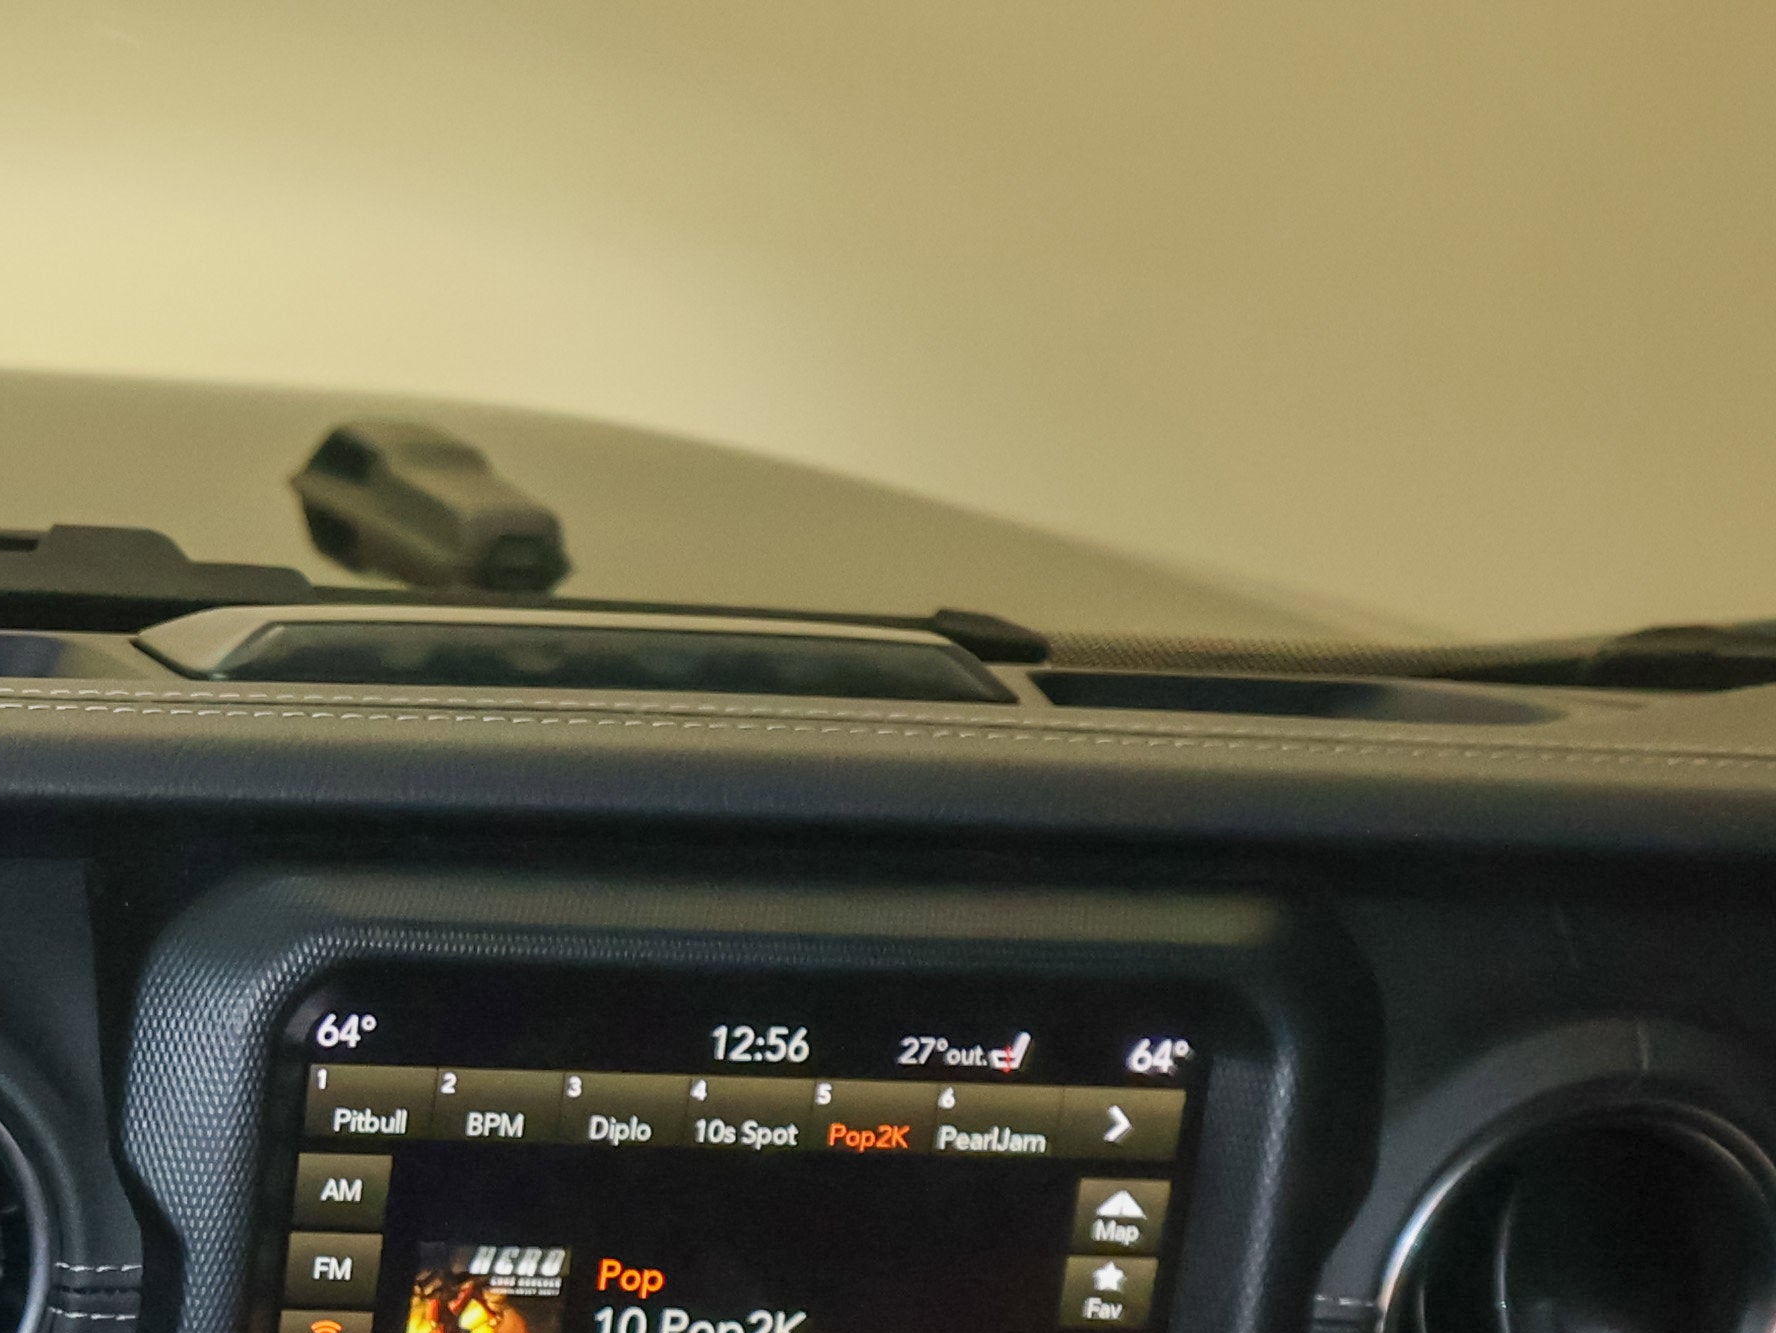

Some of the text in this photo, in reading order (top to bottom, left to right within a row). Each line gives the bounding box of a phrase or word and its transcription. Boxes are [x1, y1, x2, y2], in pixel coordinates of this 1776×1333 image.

[316, 1014, 377, 1048] 64°
[711, 1025, 810, 1063] 12:56
[1127, 1039, 1190, 1074] 64°
[317, 1070, 328, 1089] 1
[441, 1073, 457, 1093] 2
[565, 1077, 582, 1097] 3
[690, 1080, 707, 1100] 4
[815, 1083, 832, 1104] 5
[938, 1089, 955, 1108] 6
[334, 1108, 407, 1134] Pitbull
[466, 1113, 525, 1138] BPM
[588, 1115, 651, 1145] Diplo
[694, 1119, 799, 1149] 10s Spot
[827, 1124, 910, 1153] Pop2K
[320, 1179, 363, 1202] AM
[1092, 1220, 1140, 1246] Map
[312, 1257, 353, 1281] FM
[597, 1258, 665, 1298] Pop
[1084, 1297, 1123, 1320] Fav
